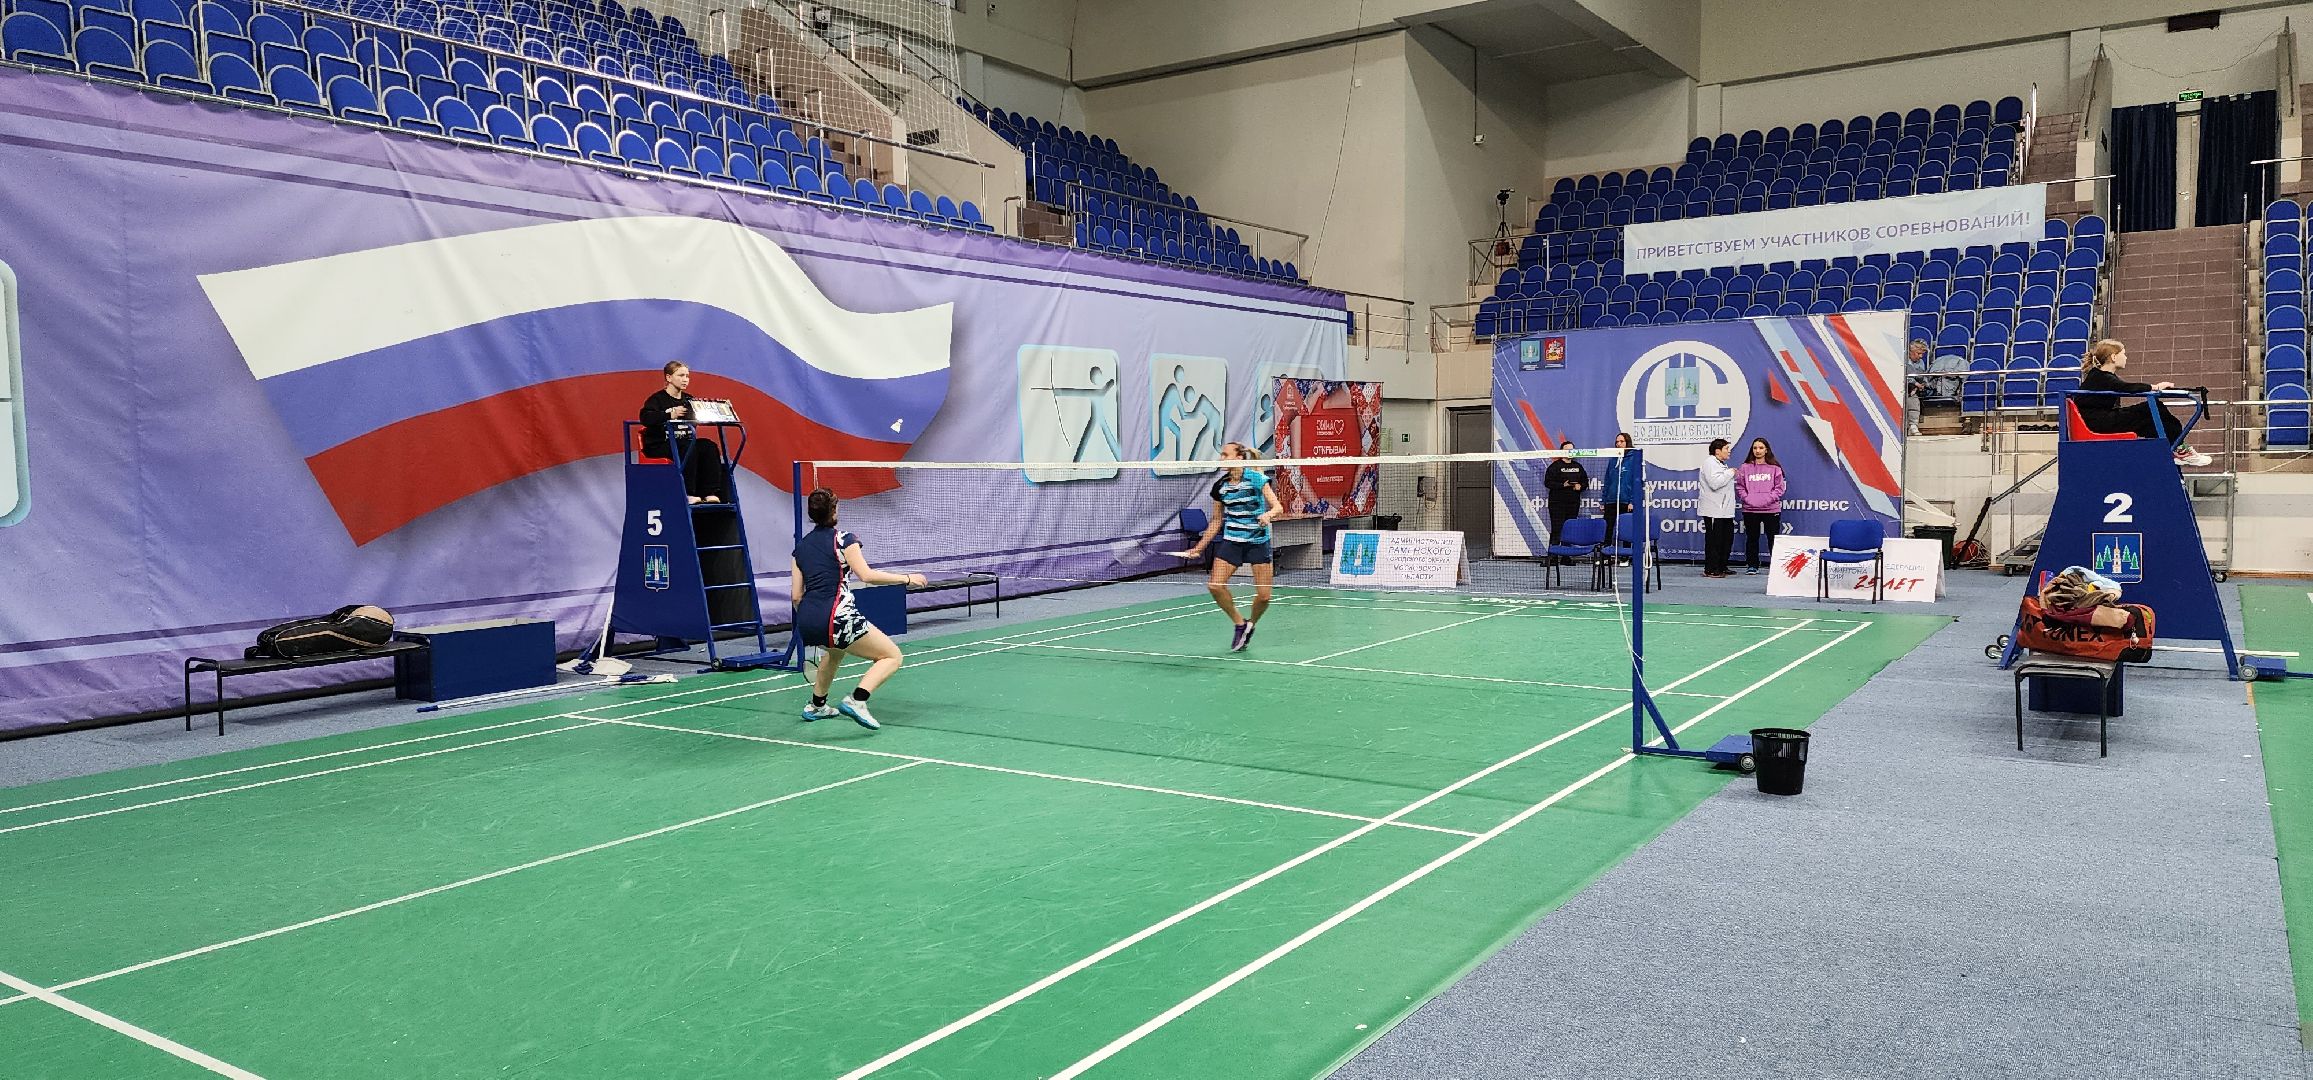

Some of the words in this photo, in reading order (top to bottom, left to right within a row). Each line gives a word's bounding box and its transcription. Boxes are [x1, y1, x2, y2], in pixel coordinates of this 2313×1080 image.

[1636, 238, 1756, 260] ПРИВЕТСТВУЕМ
[1760, 228, 1871, 250] УЧАСТНИКОВ
[1875, 210, 2030, 239] СОРЕВНОВАНИЙ!
[2103, 492, 2133, 523] 2
[647, 510, 663, 536] 5
[1882, 577, 1925, 591] ЛЕТ
